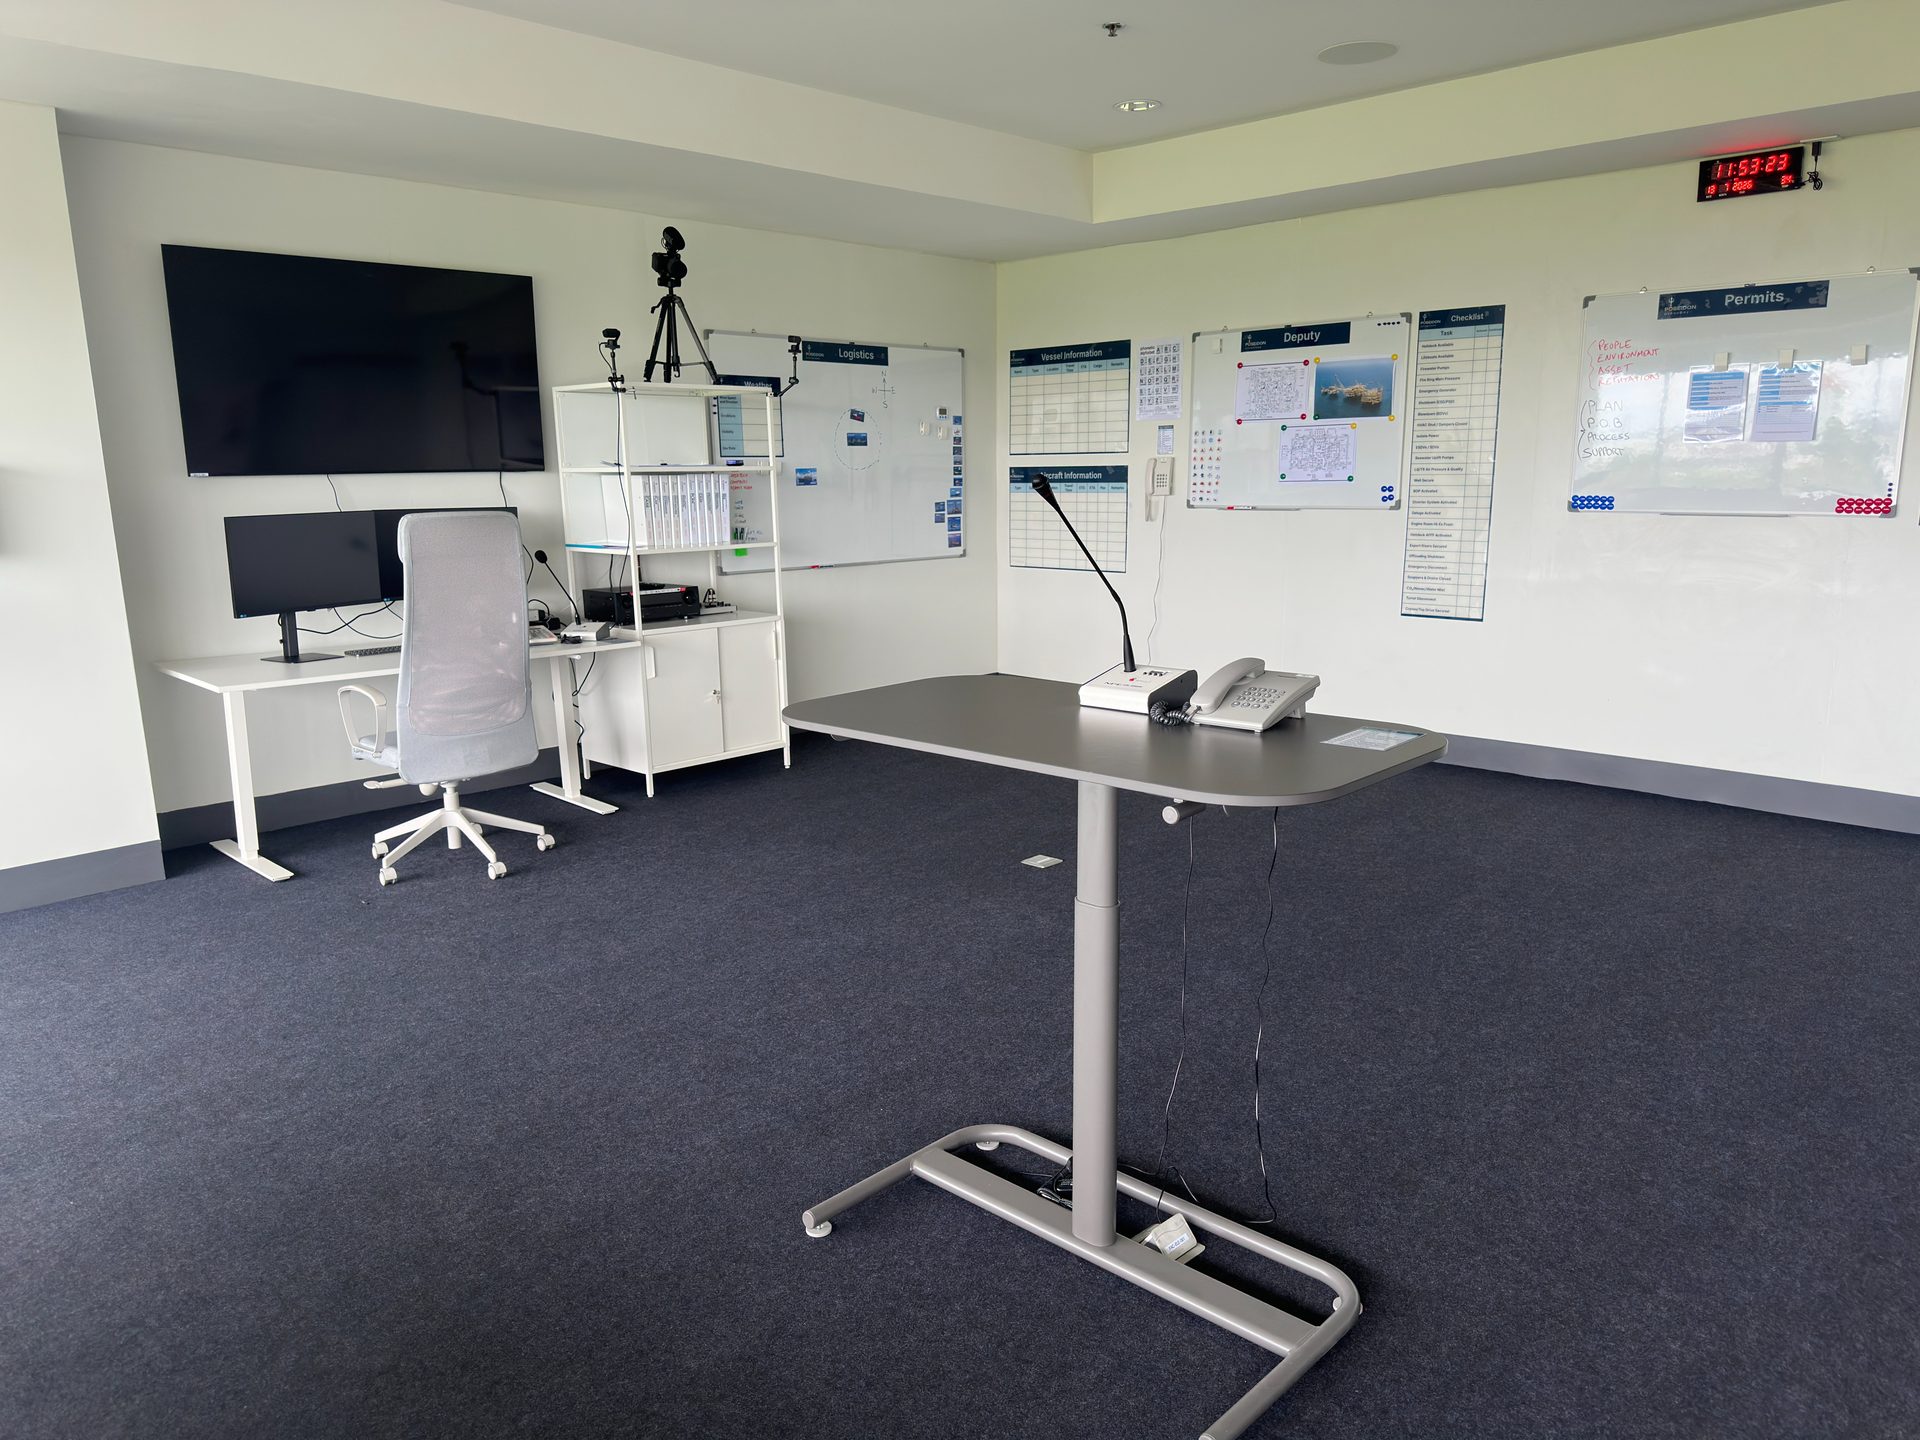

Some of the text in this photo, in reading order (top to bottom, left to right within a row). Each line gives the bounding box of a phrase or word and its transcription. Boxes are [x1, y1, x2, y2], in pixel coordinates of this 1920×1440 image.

[1724, 290, 1785, 306] Permits
[1664, 304, 1697, 312] POSEIDON
[1451, 312, 1484, 322] Checklist
[1283, 331, 1321, 344] Deputy
[1598, 338, 1633, 352] PEOPLE
[838, 348, 874, 361] Logistics
[1041, 349, 1103, 361] Vessel Information
[1597, 362, 1633, 375] ASSET
[1588, 399, 1623, 414] PLAN
[1587, 432, 1631, 443] PROCESS
[1582, 447, 1624, 459] SUPPORT
[1064, 471, 1102, 480] Information
